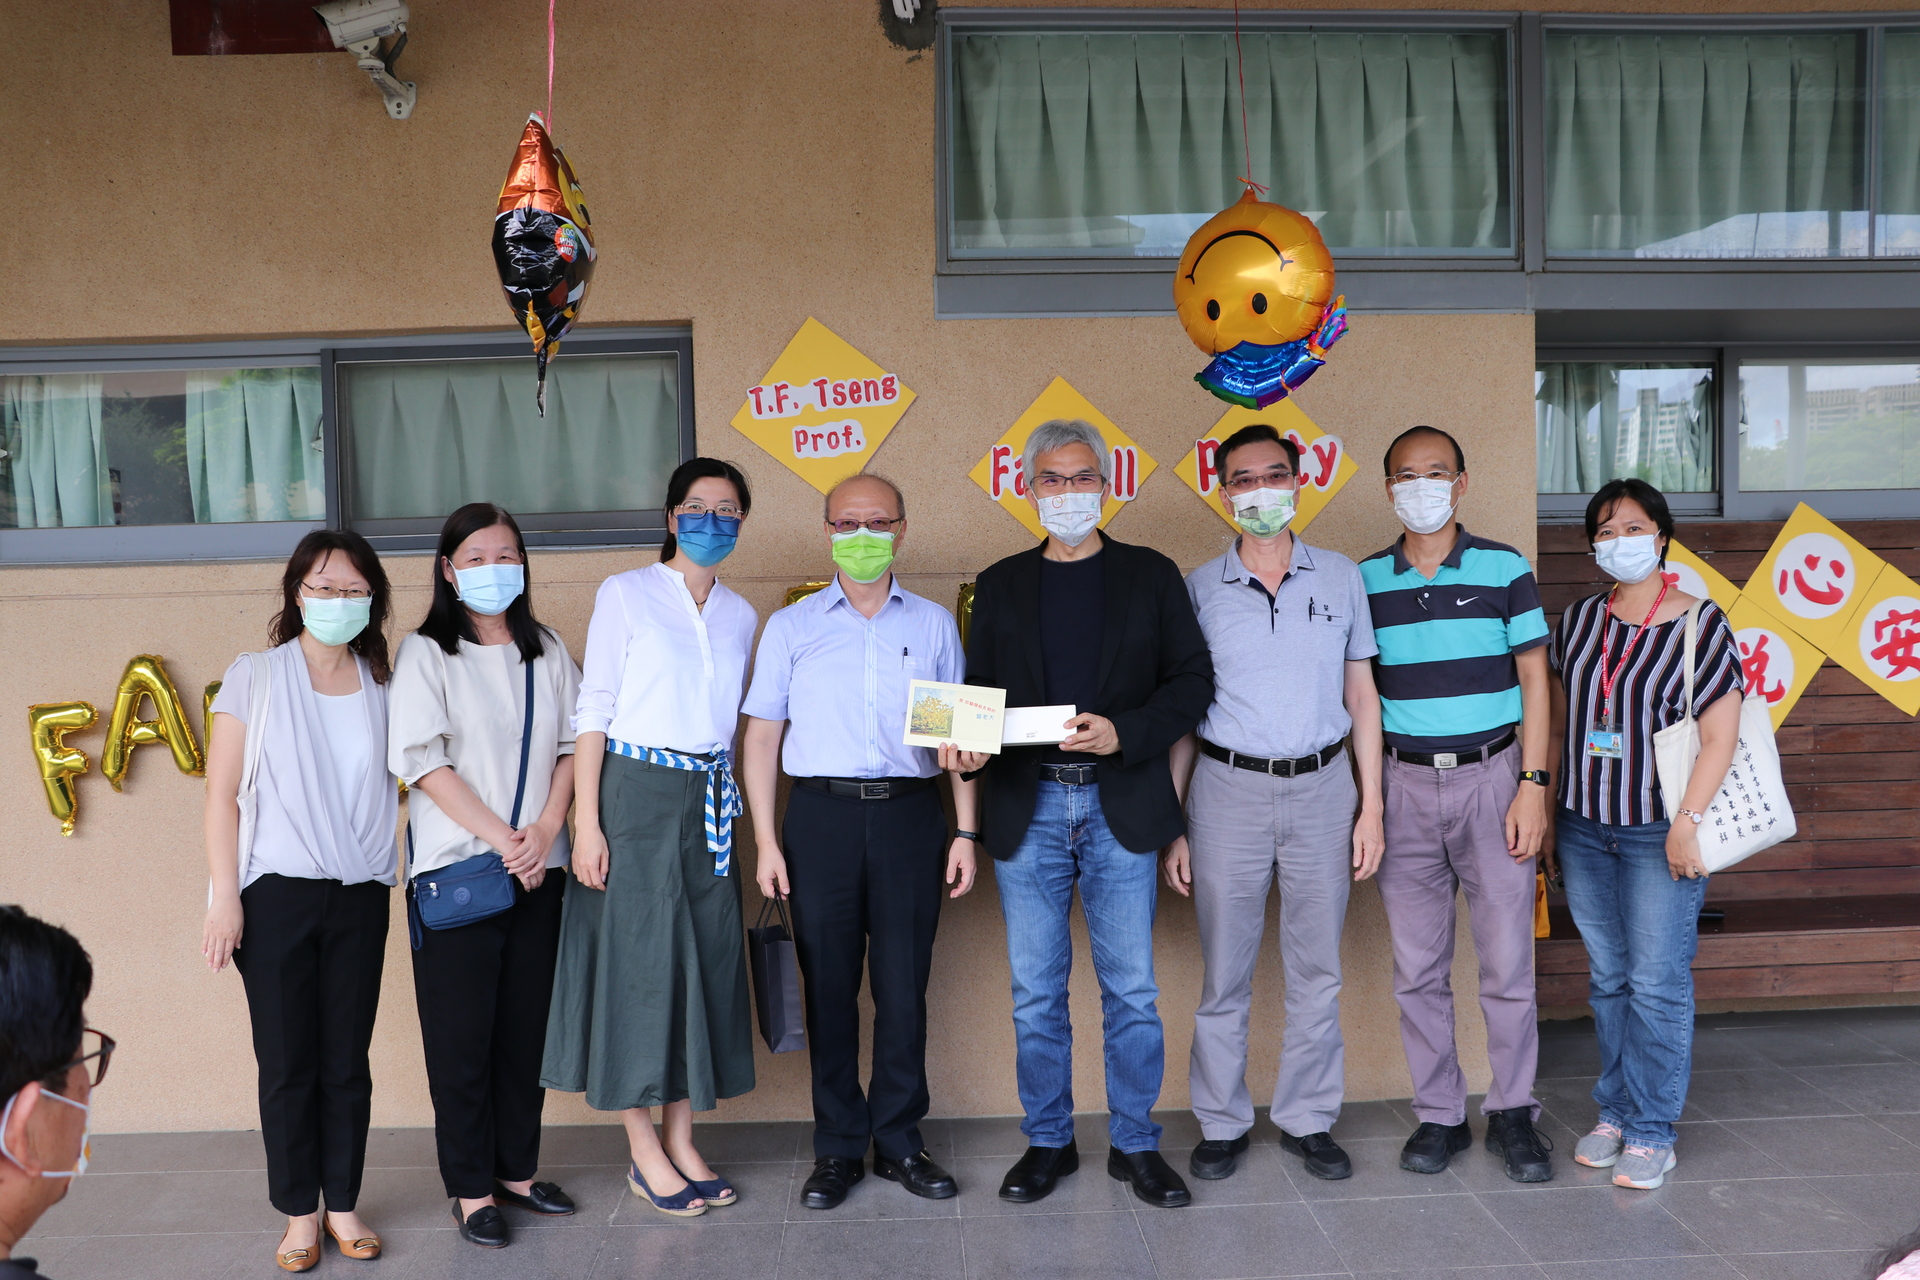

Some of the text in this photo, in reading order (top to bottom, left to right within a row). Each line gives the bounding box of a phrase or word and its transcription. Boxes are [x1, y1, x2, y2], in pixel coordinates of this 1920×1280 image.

[749, 376, 897, 415] T.F. Tseng
[1197, 434, 1337, 492] Pty
[1779, 554, 1920, 679] 心 安
